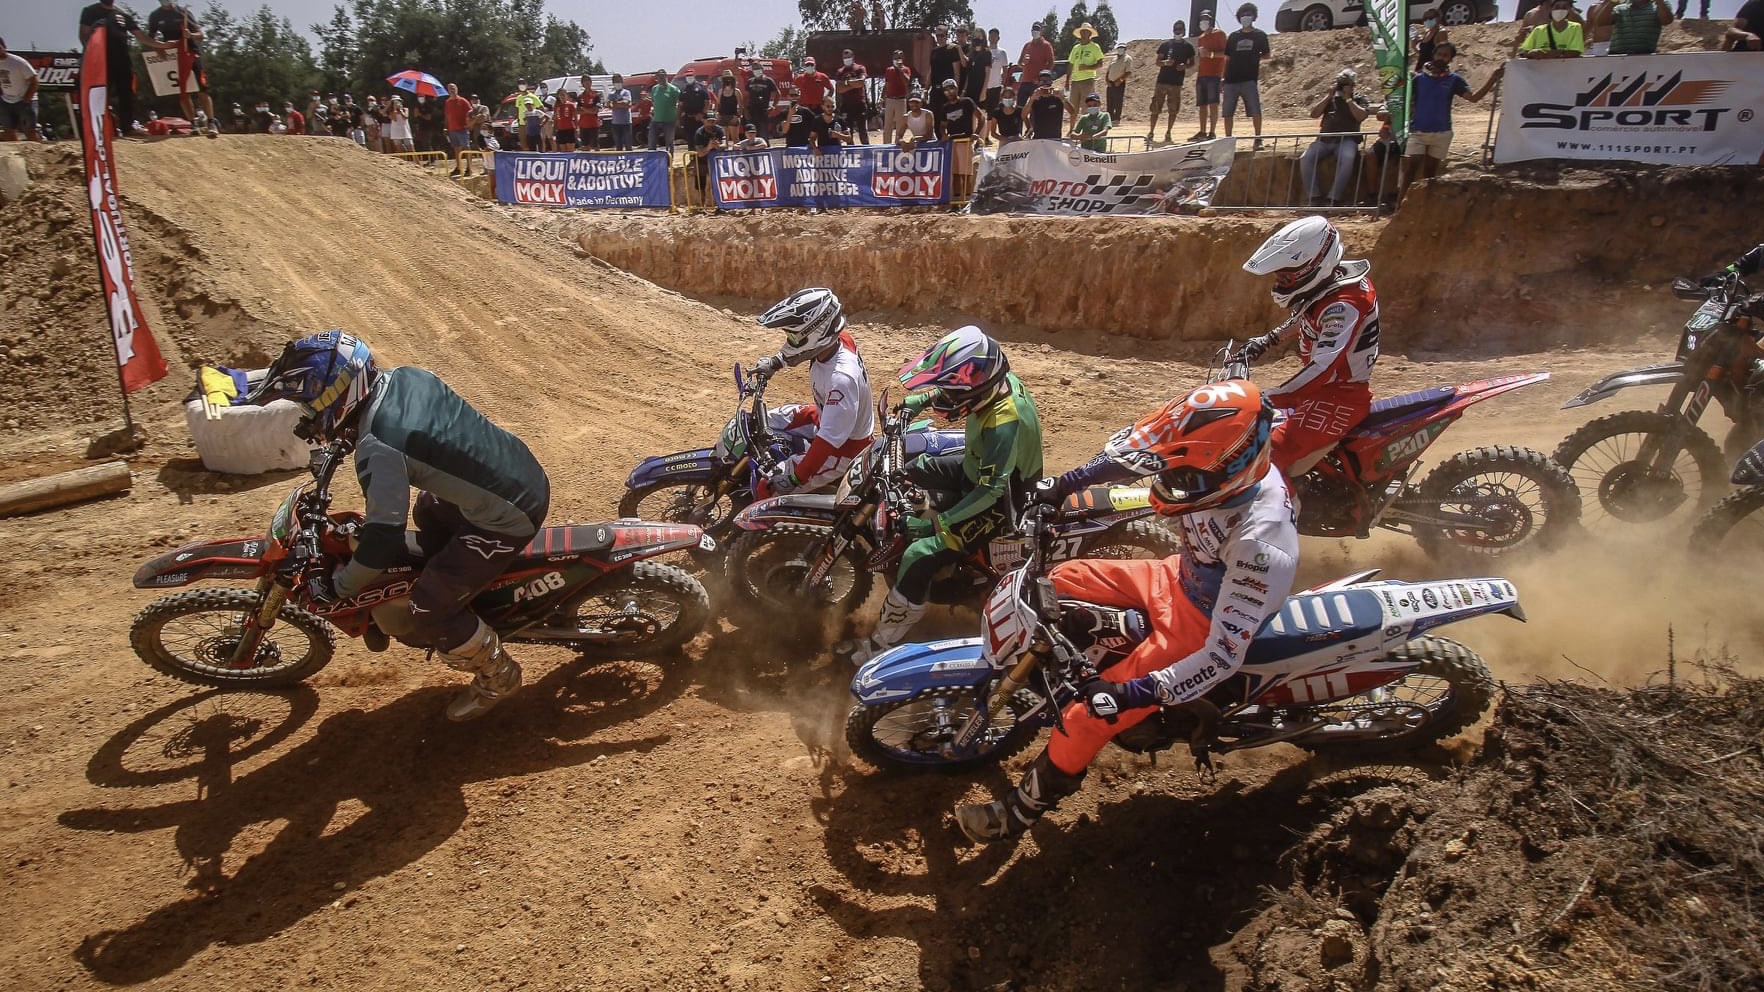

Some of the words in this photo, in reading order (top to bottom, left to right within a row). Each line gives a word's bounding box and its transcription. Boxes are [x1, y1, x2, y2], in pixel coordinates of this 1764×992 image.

[1520, 103, 1731, 132] SPORT
[1557, 141, 1697, 155] WWW.111SPORT.PT
[569, 156, 643, 174] MOTORÖLE
[718, 155, 771, 177] LIQUI
[783, 151, 862, 168] MOTORENÖLE
[877, 151, 939, 173] LIQUI
[1083, 154, 1117, 164] Benelli
[517, 159, 565, 180] LIQUI
[795, 169, 847, 182] ADDITIVE
[517, 182, 564, 203] MOLY
[720, 178, 774, 200] MOLY
[789, 182, 859, 198] AUTOPFLEGE
[875, 175, 940, 198] MOLY
[1028, 179, 1088, 197] MOTO
[568, 196, 593, 206] Made
[594, 196, 604, 205] in
[605, 195, 643, 206] Germany
[1047, 197, 1106, 213] SHOP
[156, 572, 188, 584] PLEASURE
[1173, 665, 1217, 696] create
[1287, 672, 1351, 704] 111
